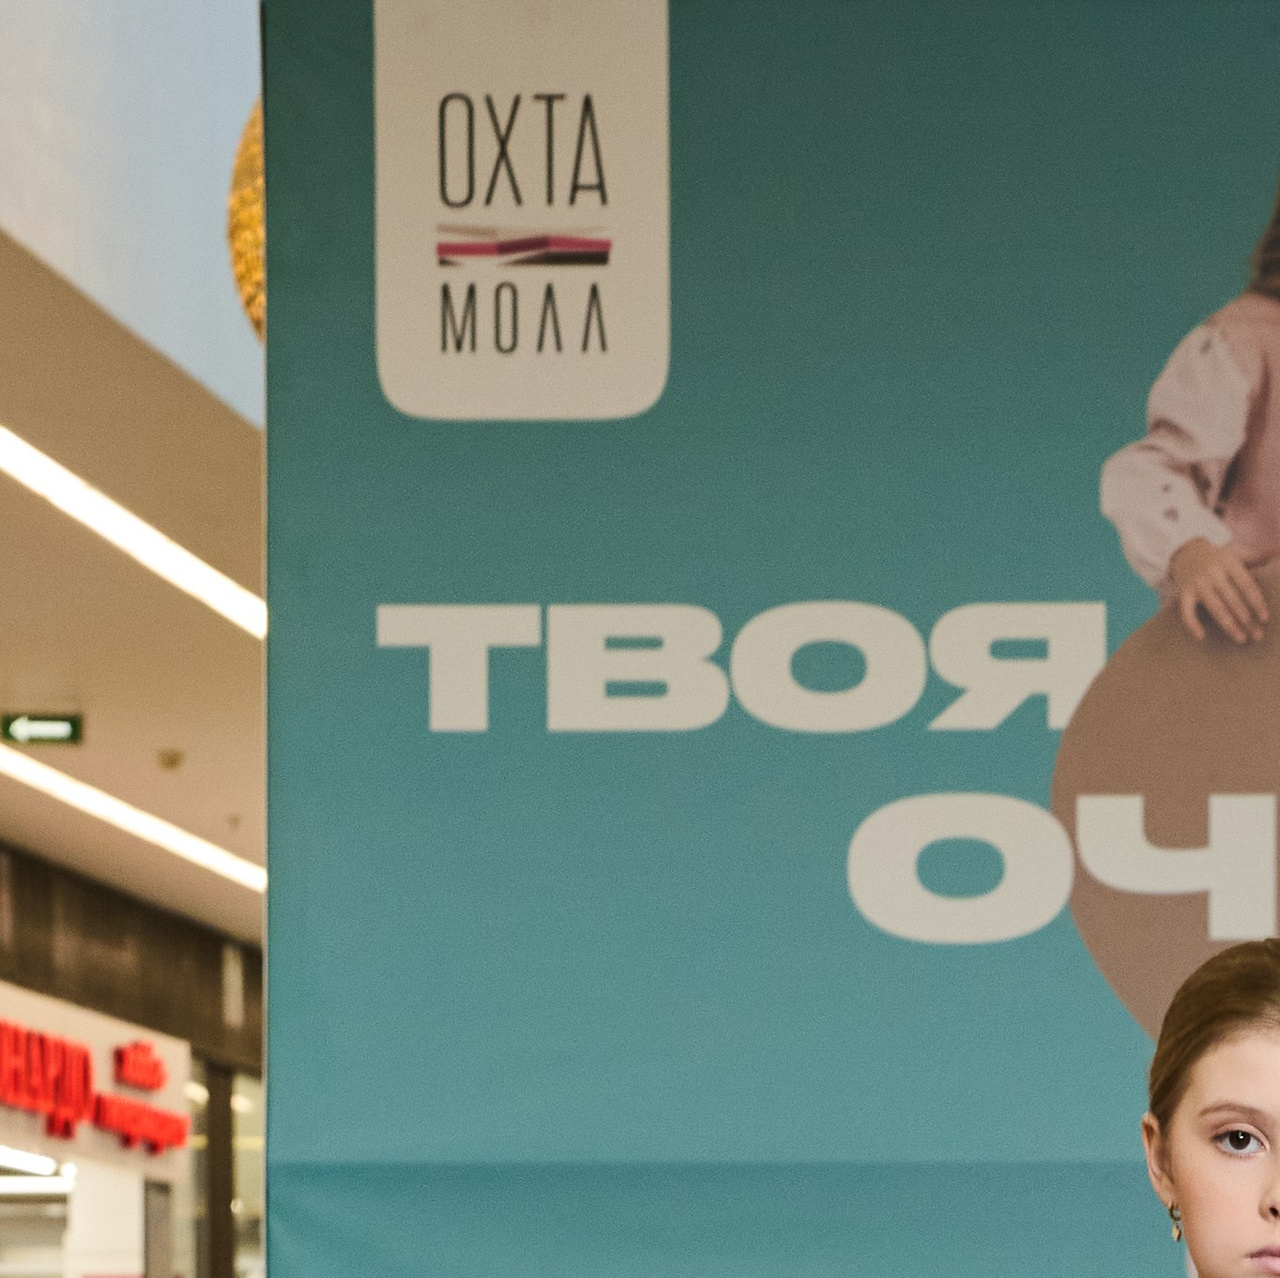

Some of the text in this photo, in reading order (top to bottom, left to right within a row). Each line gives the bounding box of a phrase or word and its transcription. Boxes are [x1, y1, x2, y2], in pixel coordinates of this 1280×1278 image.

[438, 92, 608, 207] ОХТА
[441, 281, 607, 353] МОЛЛ
[376, 600, 1108, 734] ТВОЯ
